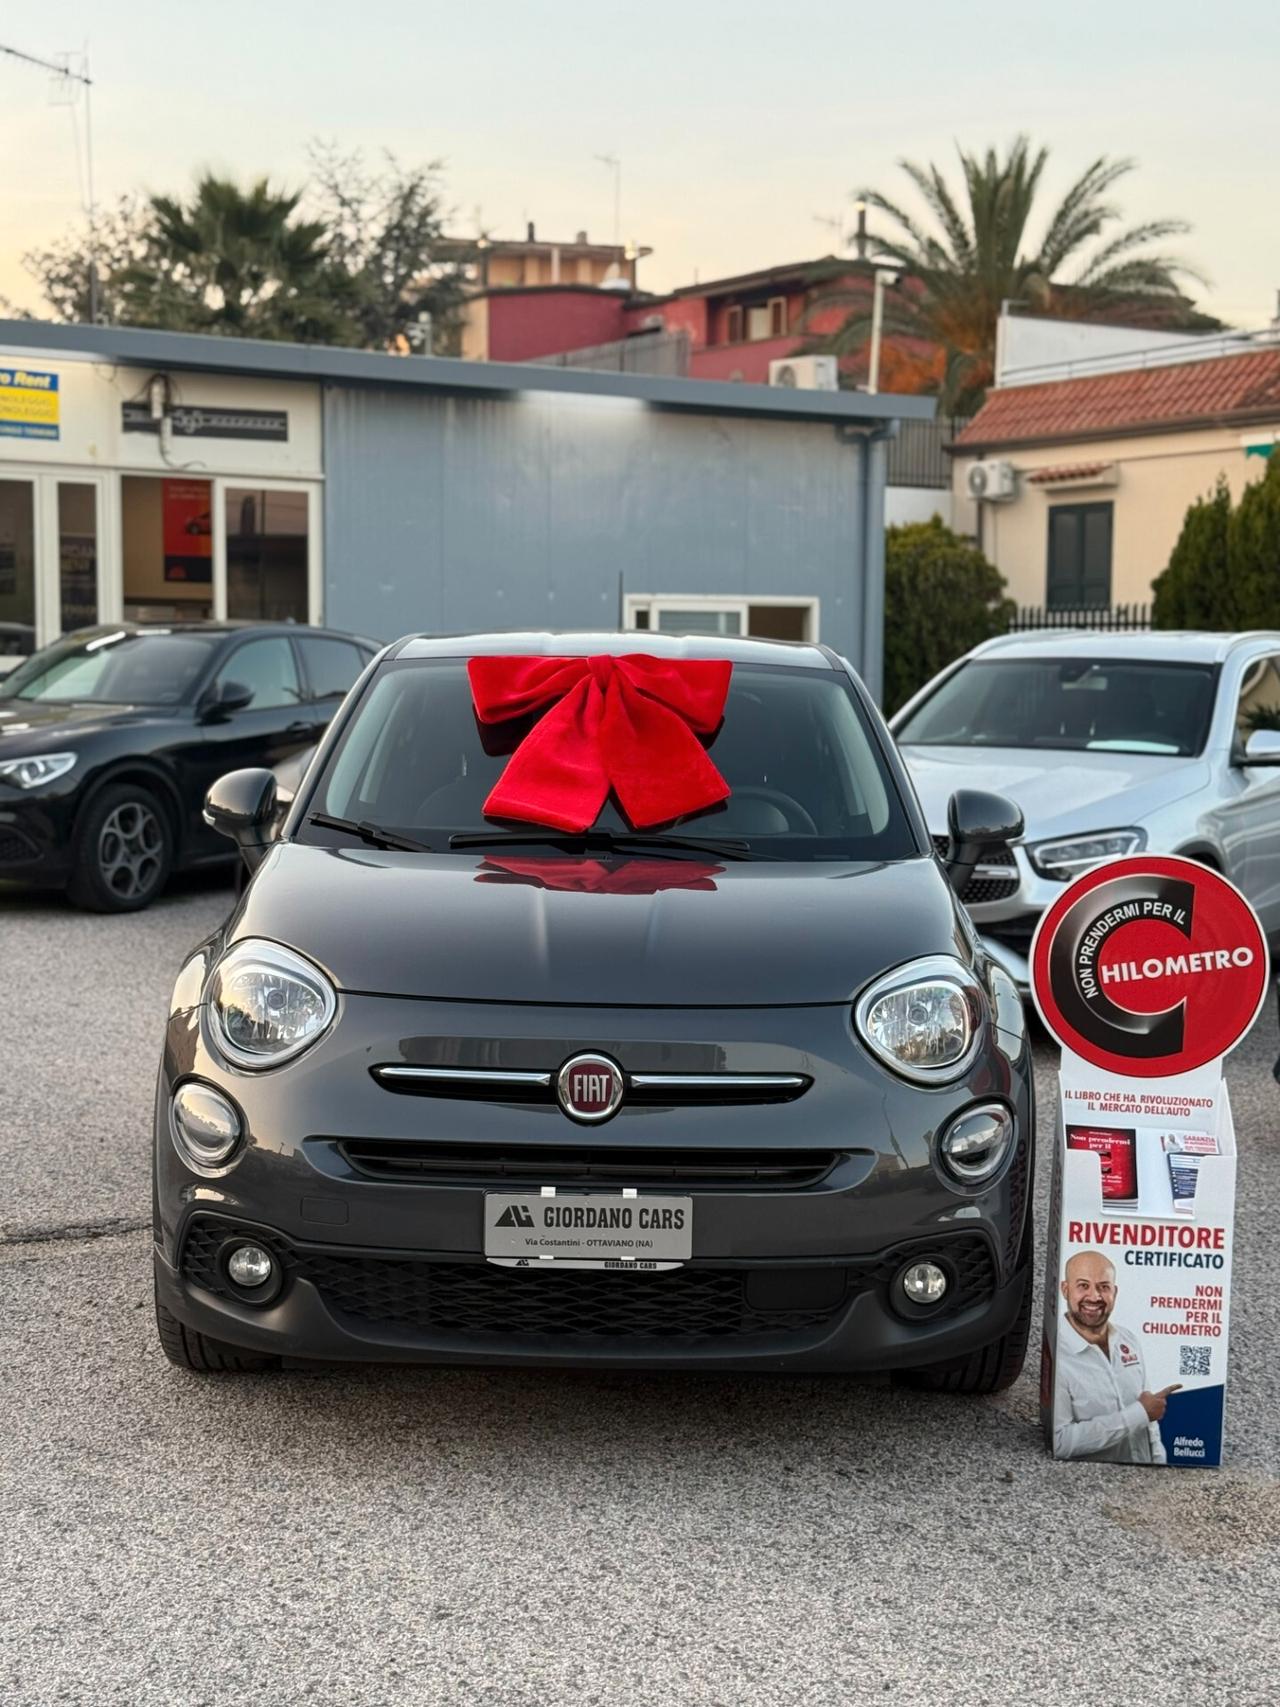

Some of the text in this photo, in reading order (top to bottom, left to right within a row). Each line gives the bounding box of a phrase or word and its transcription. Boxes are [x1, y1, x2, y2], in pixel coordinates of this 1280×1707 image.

[0, 371, 50, 388] o Rent
[1079, 901, 1185, 999] NON PRENDERMI PER IL
[573, 1074, 610, 1102] FIAT
[1065, 1090, 1213, 1108] IL LIBRO CHE HA RIVOLUZIONATO
[1088, 1103, 1191, 1117] IL MERCATO DELL'AUTO
[543, 1206, 632, 1229] GIORDANO
[638, 1208, 685, 1230] CARS
[1068, 1221, 1225, 1249] RIVENDITORE
[525, 1238, 538, 1246] Via
[539, 1238, 581, 1247] Costantini
[586, 1239, 634, 1248] OTTAVIANO
[635, 1239, 653, 1248] (NA)
[604, 1261, 638, 1269] GIORDANO
[639, 1262, 657, 1270] CARS
[1124, 1250, 1224, 1269] CERTIFICATO
[1195, 1285, 1223, 1297] NON
[1151, 1297, 1222, 1310] PRENDERMI
[1185, 1311, 1222, 1324] PER IL
[1143, 1322, 1221, 1337] CHILOMETRO
[1173, 1436, 1204, 1447] Alfredo
[1173, 1448, 1205, 1457] Bellucci
